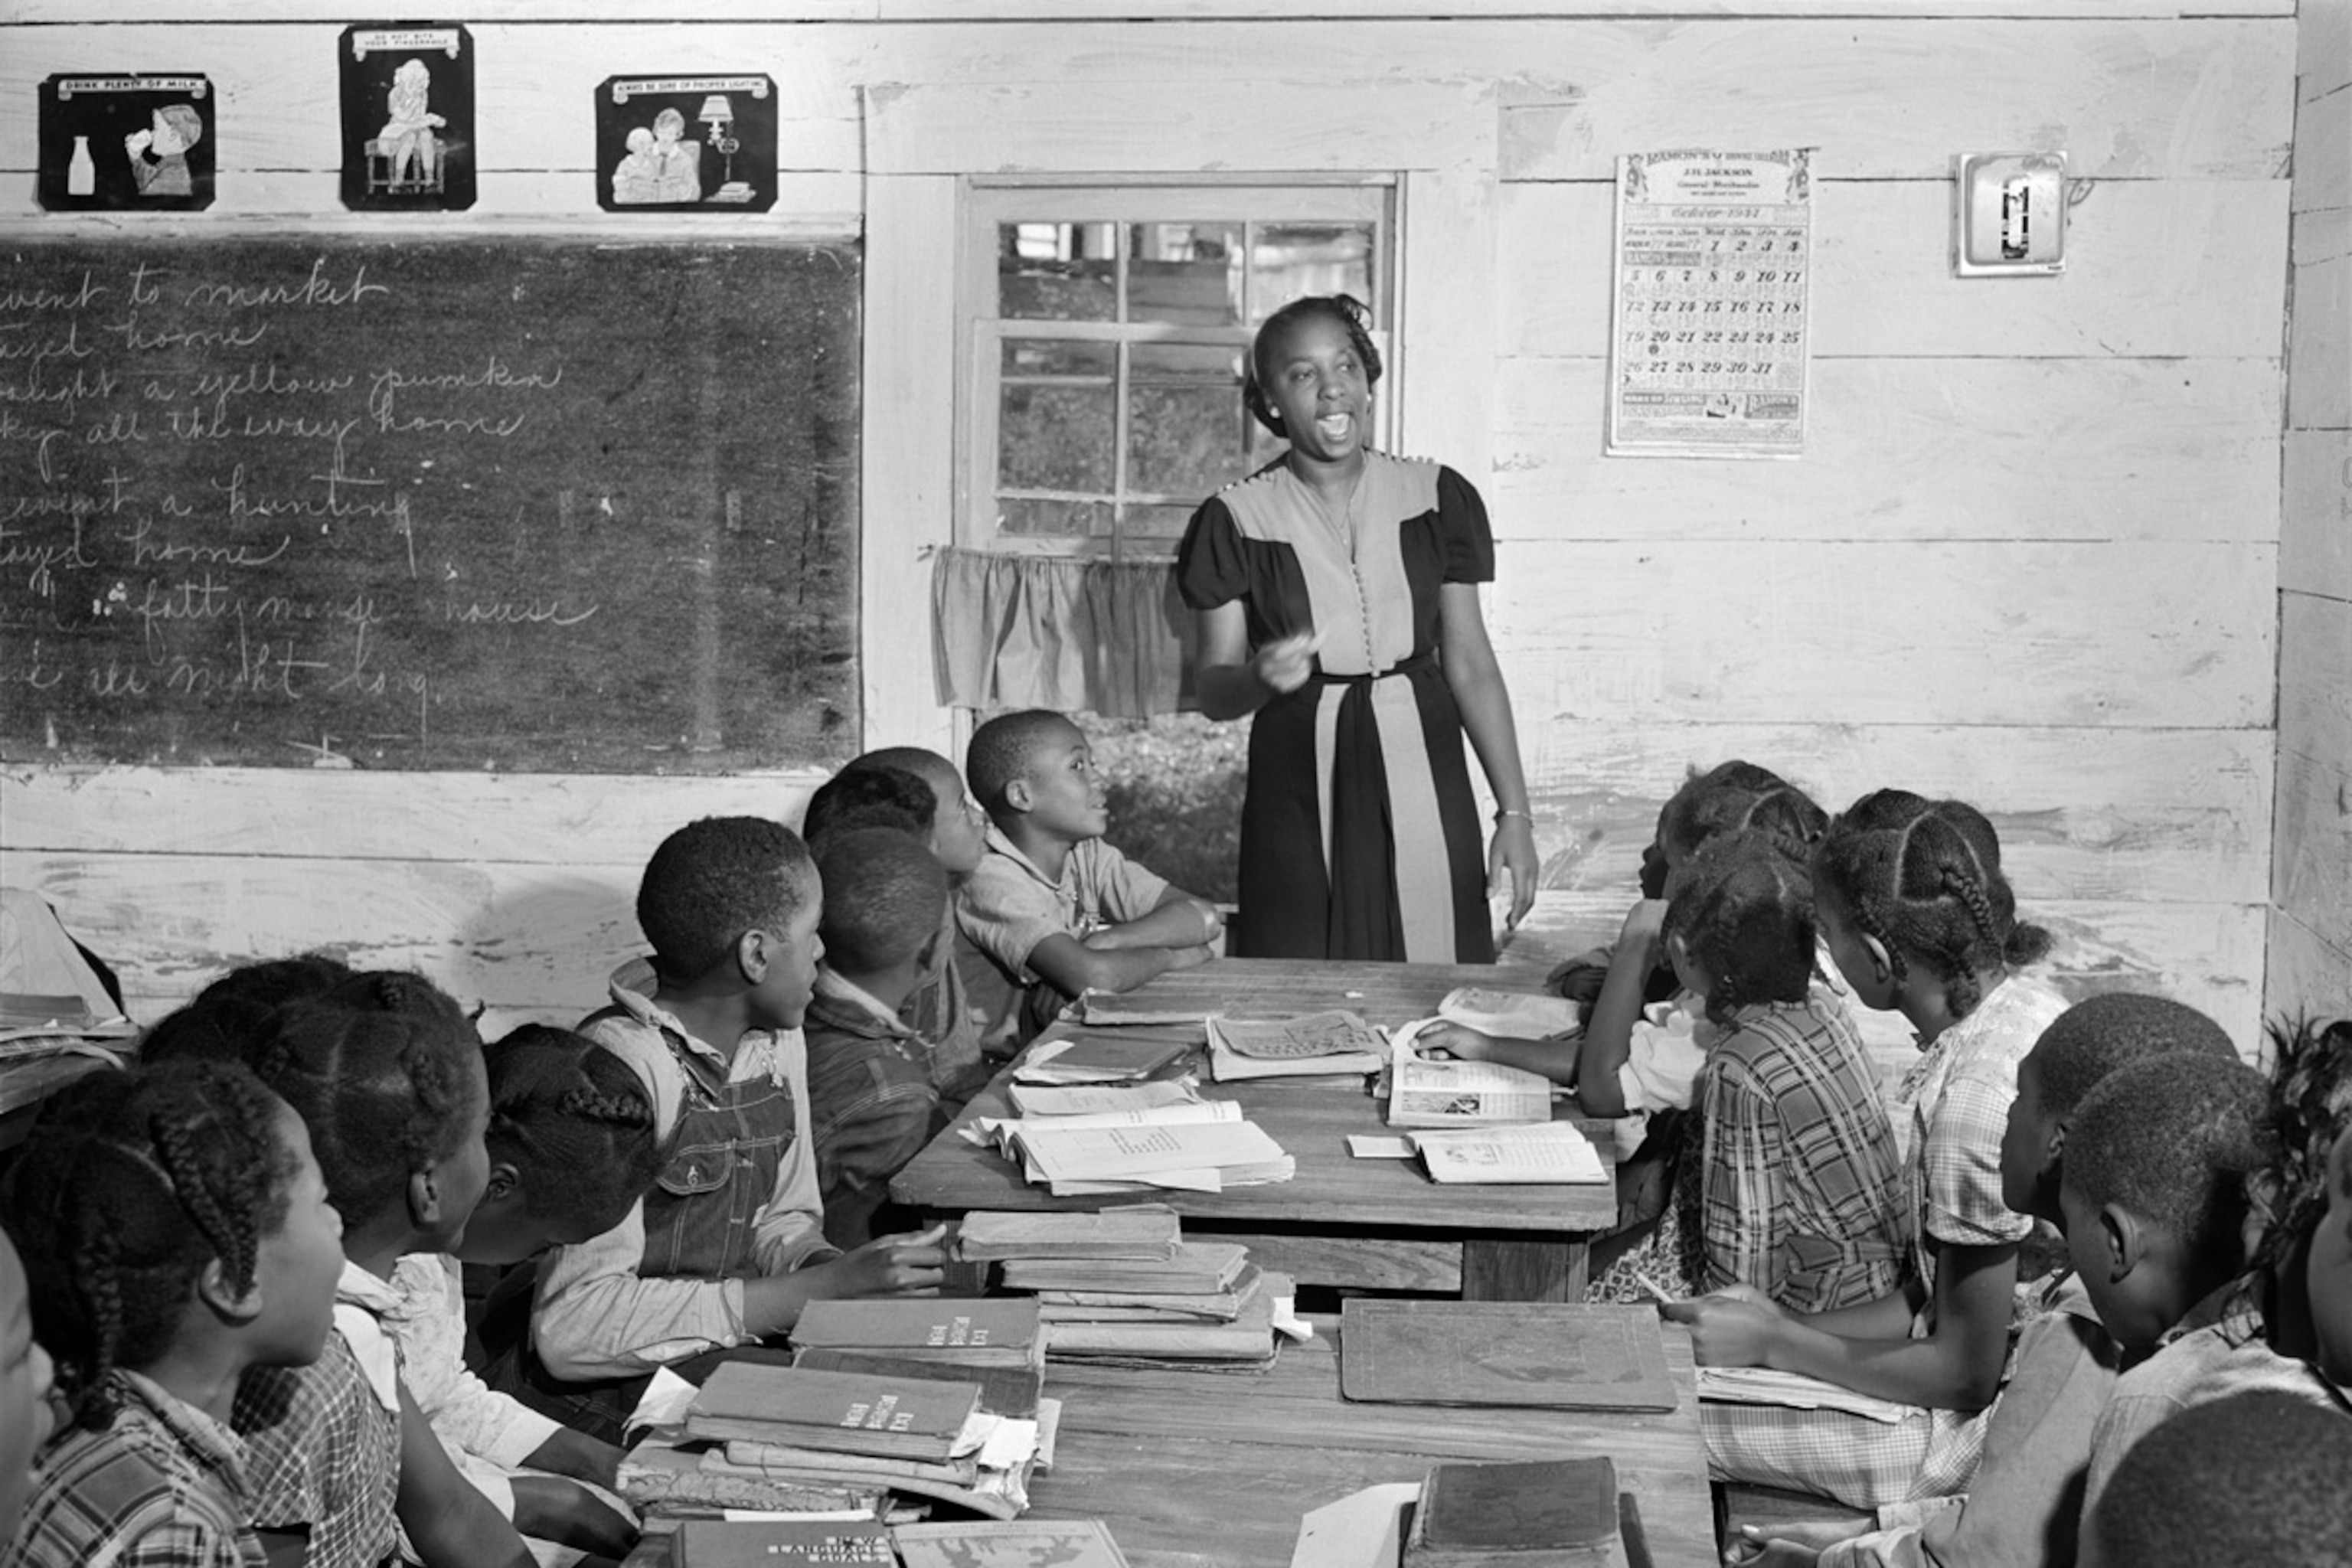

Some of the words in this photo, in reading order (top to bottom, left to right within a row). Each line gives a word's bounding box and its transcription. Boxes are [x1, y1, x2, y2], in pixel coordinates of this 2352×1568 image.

[67, 79, 99, 88] DRINK
[105, 78, 142, 88] PLENTY
[147, 77, 162, 87] OF
[167, 78, 197, 87] MILK
[1705, 167, 1753, 177] JACKSON
[1710, 241, 1719, 253] 1
[1736, 241, 1746, 251] 2
[1762, 241, 1772, 251] 3
[128, 261, 170, 305] to
[185, 256, 389, 307] market
[1656, 270, 1666, 282] 6
[1710, 270, 1718, 282] 8
[1735, 270, 1746, 282] 9
[1758, 272, 1775, 282] 10
[1784, 272, 1801, 283] 11
[1652, 301, 1671, 312] 13
[1678, 302, 1695, 312] 14
[1704, 301, 1722, 312] 15
[1731, 302, 1749, 312] 16
[1757, 302, 1774, 312] 17
[1784, 302, 1800, 312] 18
[103, 309, 266, 350] home
[1651, 332, 1670, 343] 20
[1677, 332, 1695, 343] 21
[1703, 332, 1723, 343] 22
[1729, 332, 1749, 343] 23
[1755, 332, 1774, 343] 24
[1782, 332, 1799, 343] 25
[1649, 361, 1668, 373] 27
[1676, 362, 1694, 373] 28
[1701, 362, 1722, 373] 29
[1726, 362, 1747, 373] 30
[1753, 363, 1772, 374] 31
[144, 381, 176, 401] a
[190, 364, 354, 426] yellow
[86, 412, 148, 444] all
[165, 406, 231, 439] the
[244, 417, 360, 479] way
[380, 407, 526, 437] home
[162, 495, 193, 517] a
[211, 461, 416, 579] hunting
[114, 514, 289, 566] home
[776, 1545, 876, 1554] LANGUAGE
